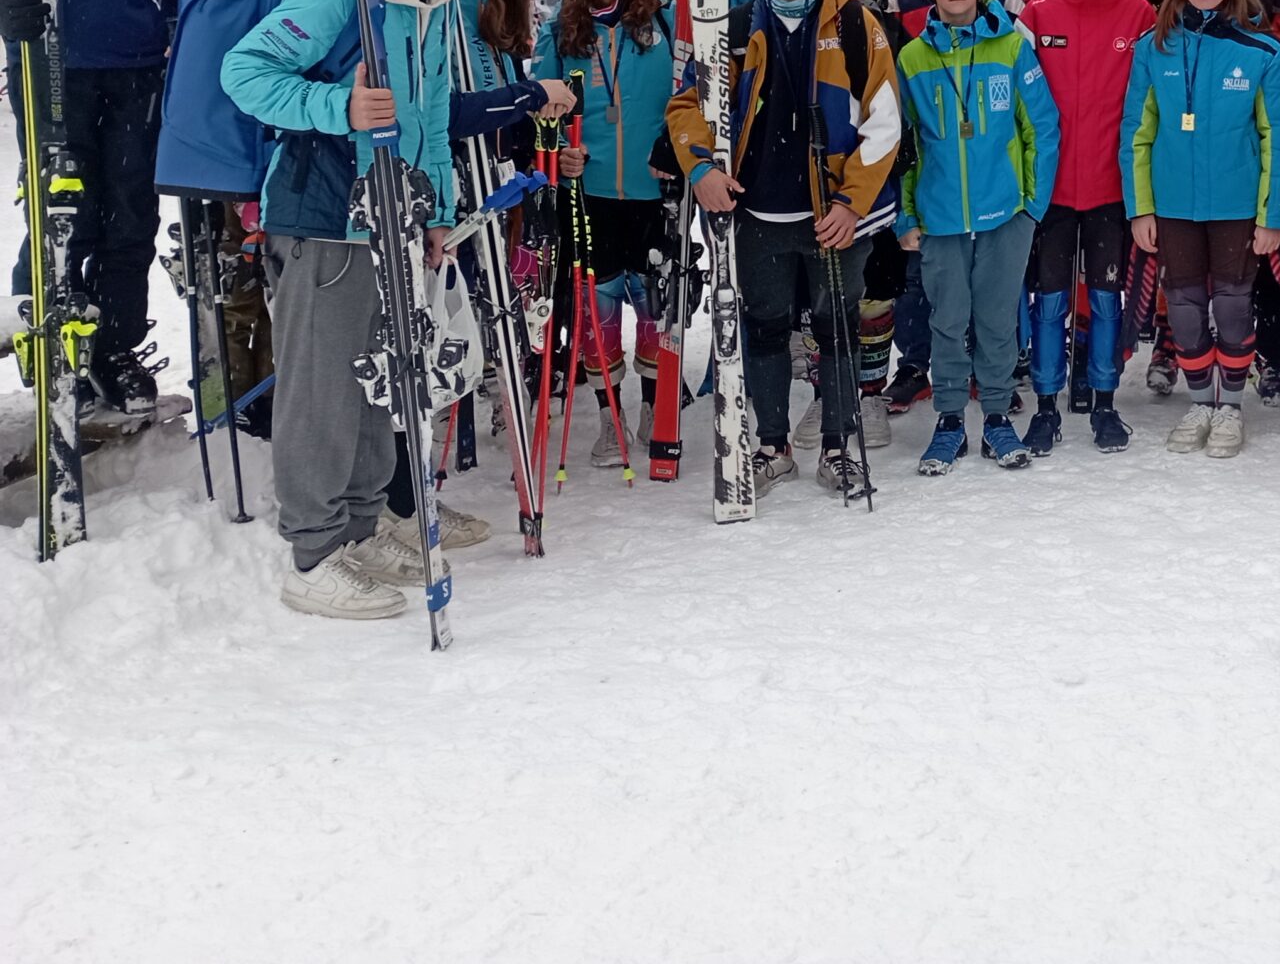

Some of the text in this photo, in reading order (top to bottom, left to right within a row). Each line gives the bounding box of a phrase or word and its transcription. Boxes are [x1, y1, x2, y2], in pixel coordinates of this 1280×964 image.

[50, 30, 63, 104] ROSSIGNO
[471, 36, 494, 87] VERTICA
[718, 31, 732, 141] ROSSIGNOL
